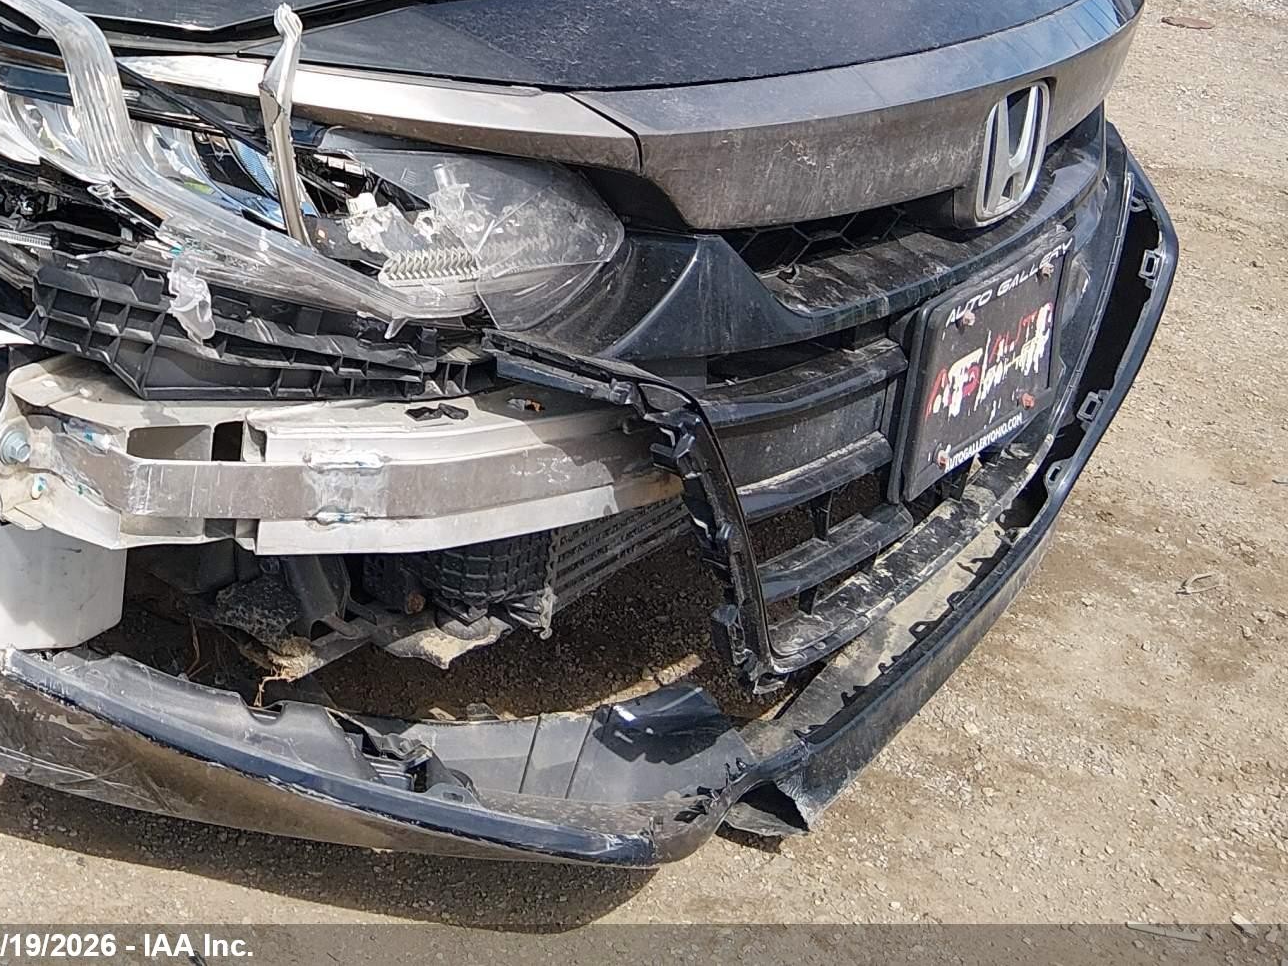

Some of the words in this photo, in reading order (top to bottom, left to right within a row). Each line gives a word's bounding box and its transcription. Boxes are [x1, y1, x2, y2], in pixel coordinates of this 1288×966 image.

[945, 289, 993, 328] AUTO
[997, 237, 1073, 297] GALLERY
[944, 412, 1023, 473] AUTOGALLERYOHIO.COM
